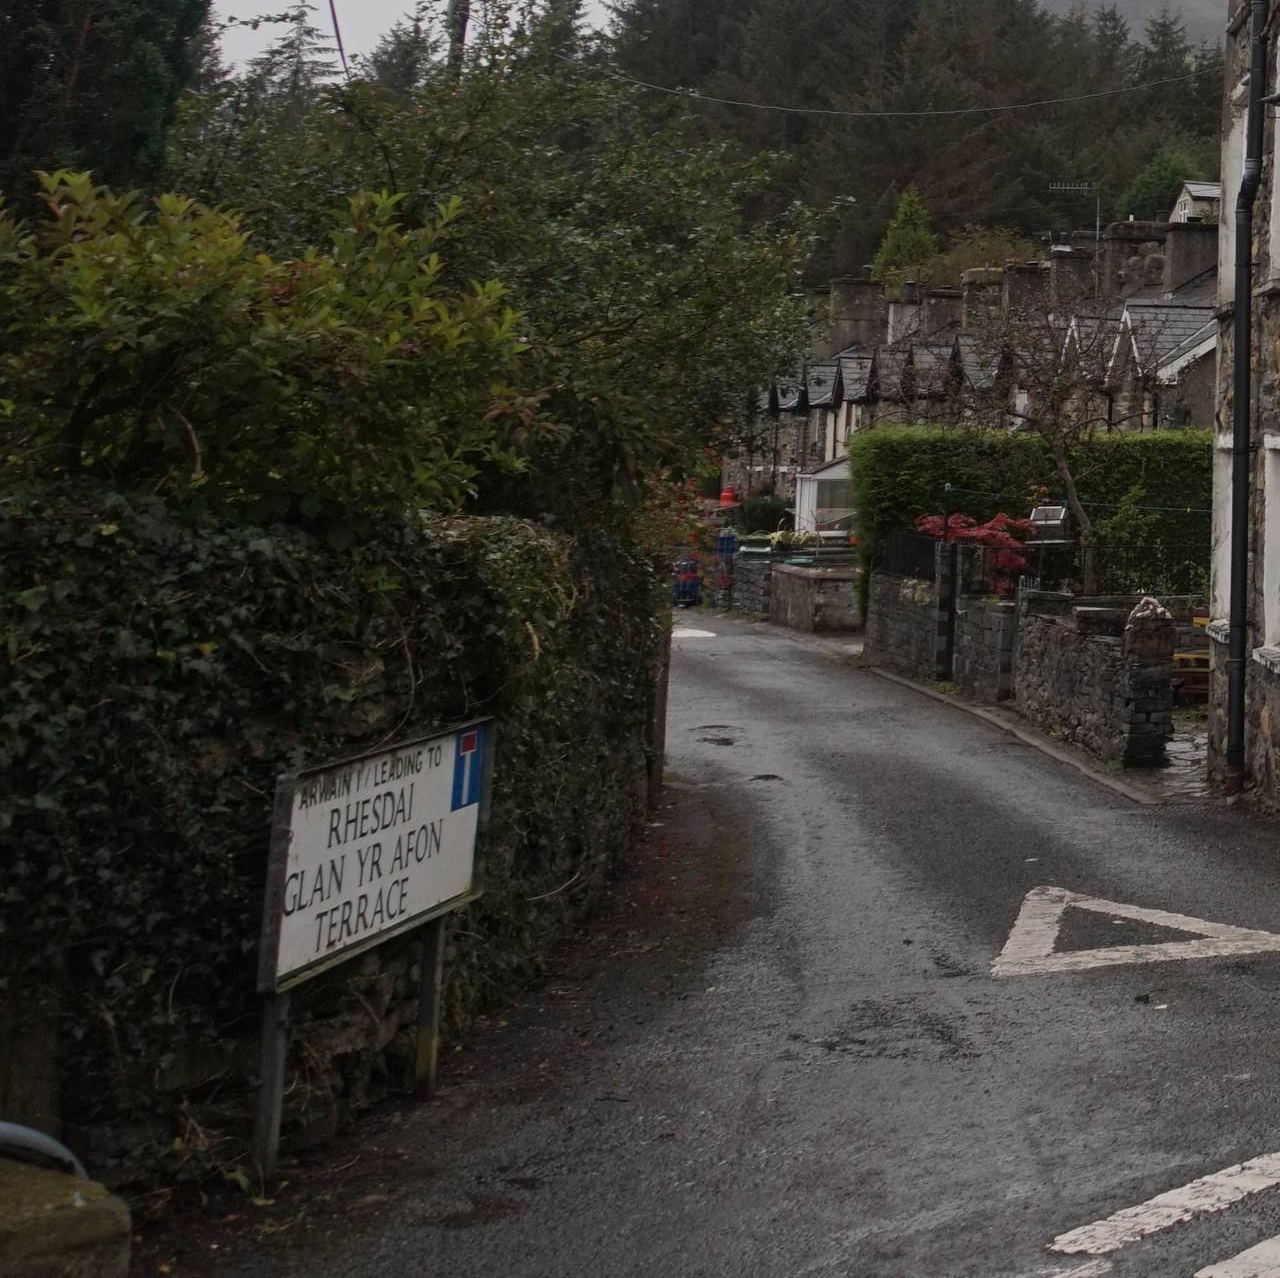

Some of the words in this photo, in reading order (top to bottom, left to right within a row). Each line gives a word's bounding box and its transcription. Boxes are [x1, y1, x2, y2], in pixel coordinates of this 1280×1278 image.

[299, 772, 351, 811] ARWAIN
[374, 751, 423, 788] LEADING
[429, 745, 442, 769] TO
[327, 783, 414, 848] RHESDAI
[284, 855, 345, 917] GLAN
[357, 842, 382, 887] YR
[390, 818, 443, 874] AFON
[315, 877, 409, 952] TERRACE
